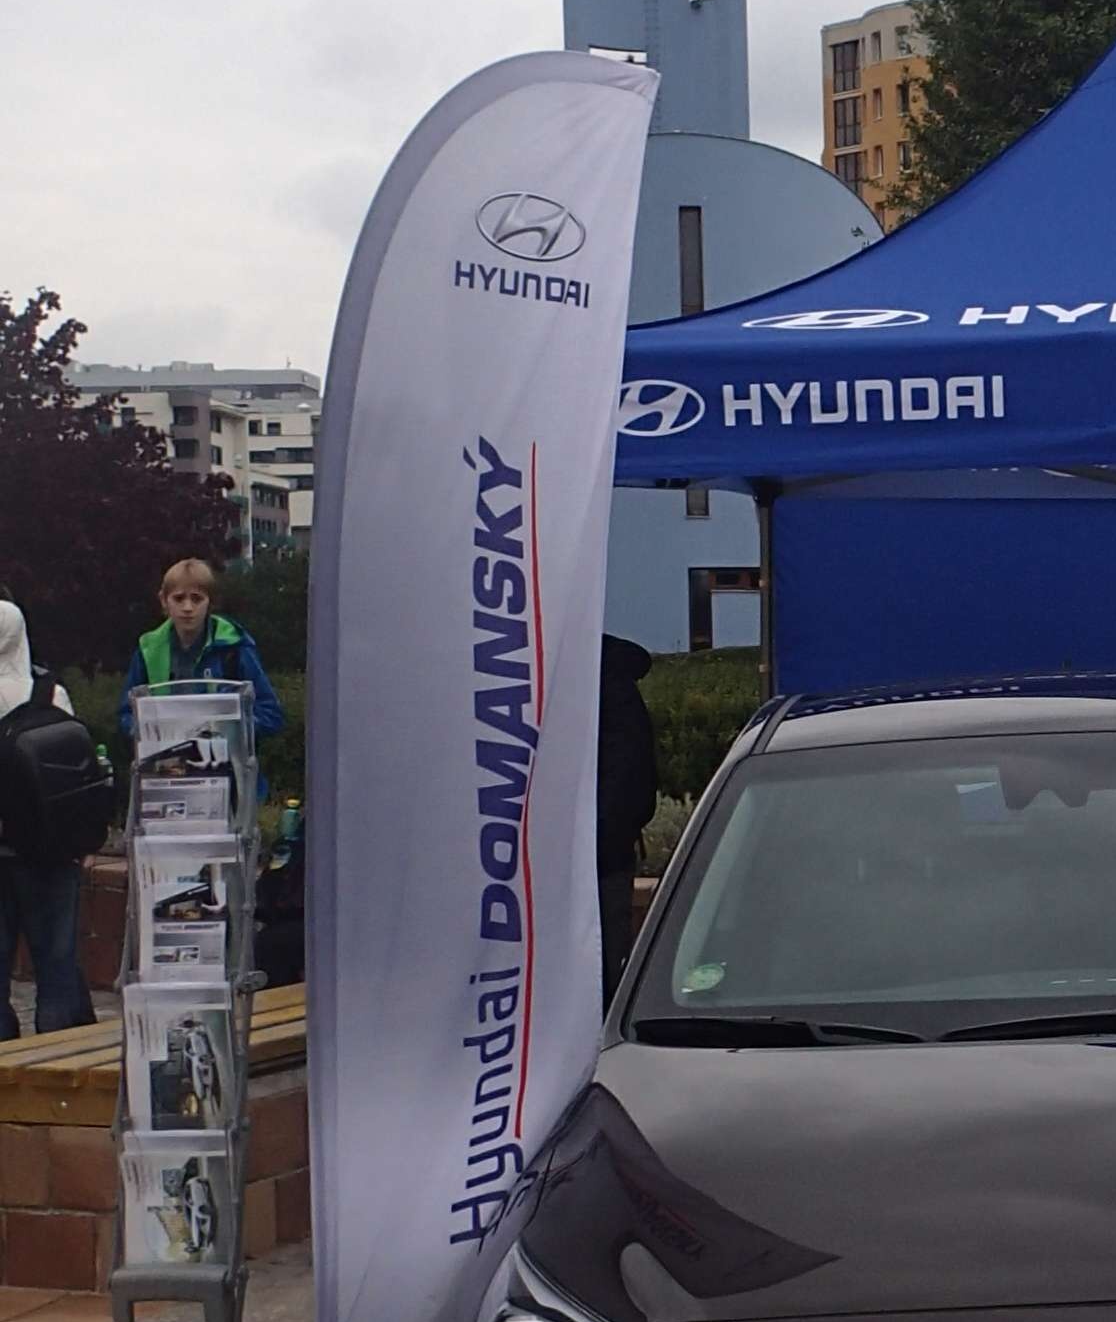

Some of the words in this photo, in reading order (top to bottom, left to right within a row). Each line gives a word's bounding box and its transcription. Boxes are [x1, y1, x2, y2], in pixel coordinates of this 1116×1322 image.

[454, 260, 590, 309] HYUNDAI
[722, 375, 1004, 427] HYUNDAI
[462, 435, 540, 943] DOMANSKÝ
[449, 965, 525, 1245] Hyundai
